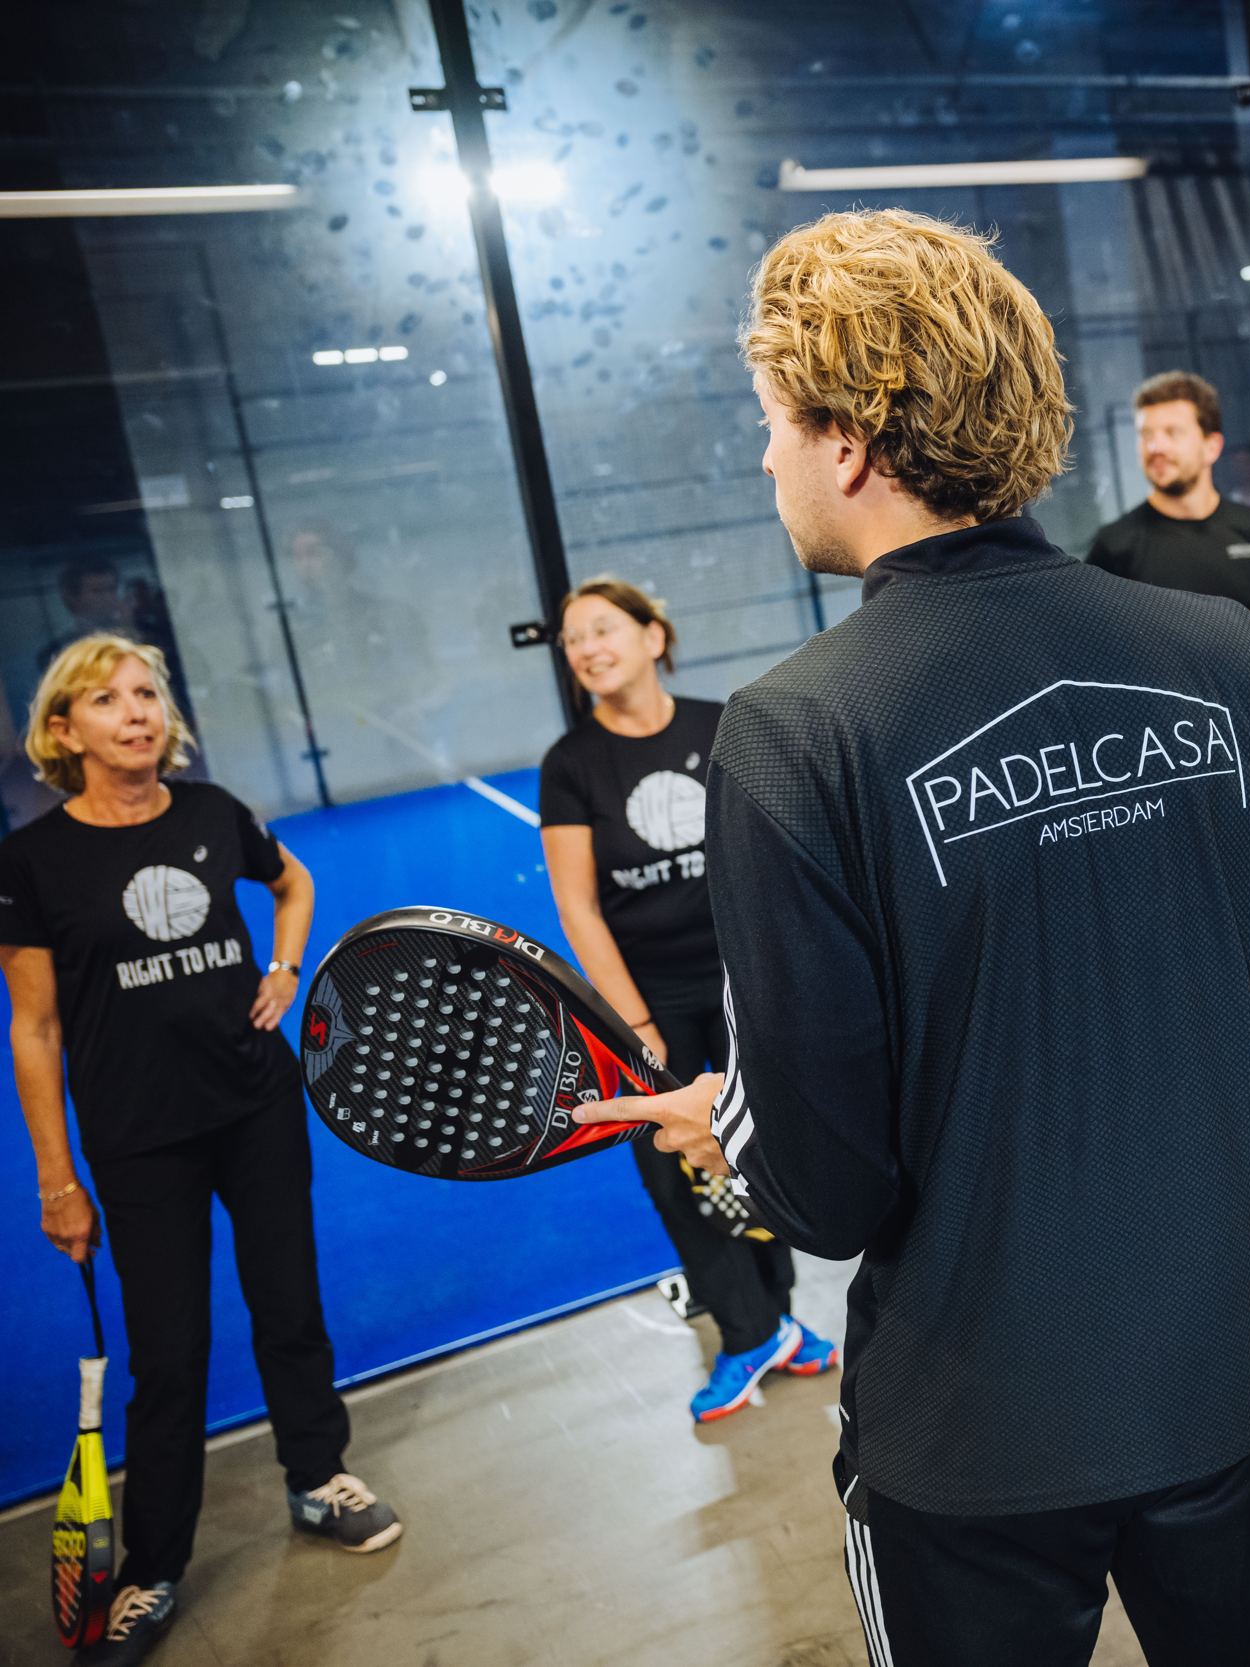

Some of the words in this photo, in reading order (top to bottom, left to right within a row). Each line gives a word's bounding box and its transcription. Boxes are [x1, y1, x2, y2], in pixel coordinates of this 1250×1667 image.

[924, 718, 1234, 831] PADELCASA
[1039, 798, 1165, 846] AMSTERDAM
[429, 912, 545, 961] DIABLO
[116, 952, 174, 989] RIGHT
[175, 946, 205, 976] TO
[551, 1051, 582, 1129] DIABLO
